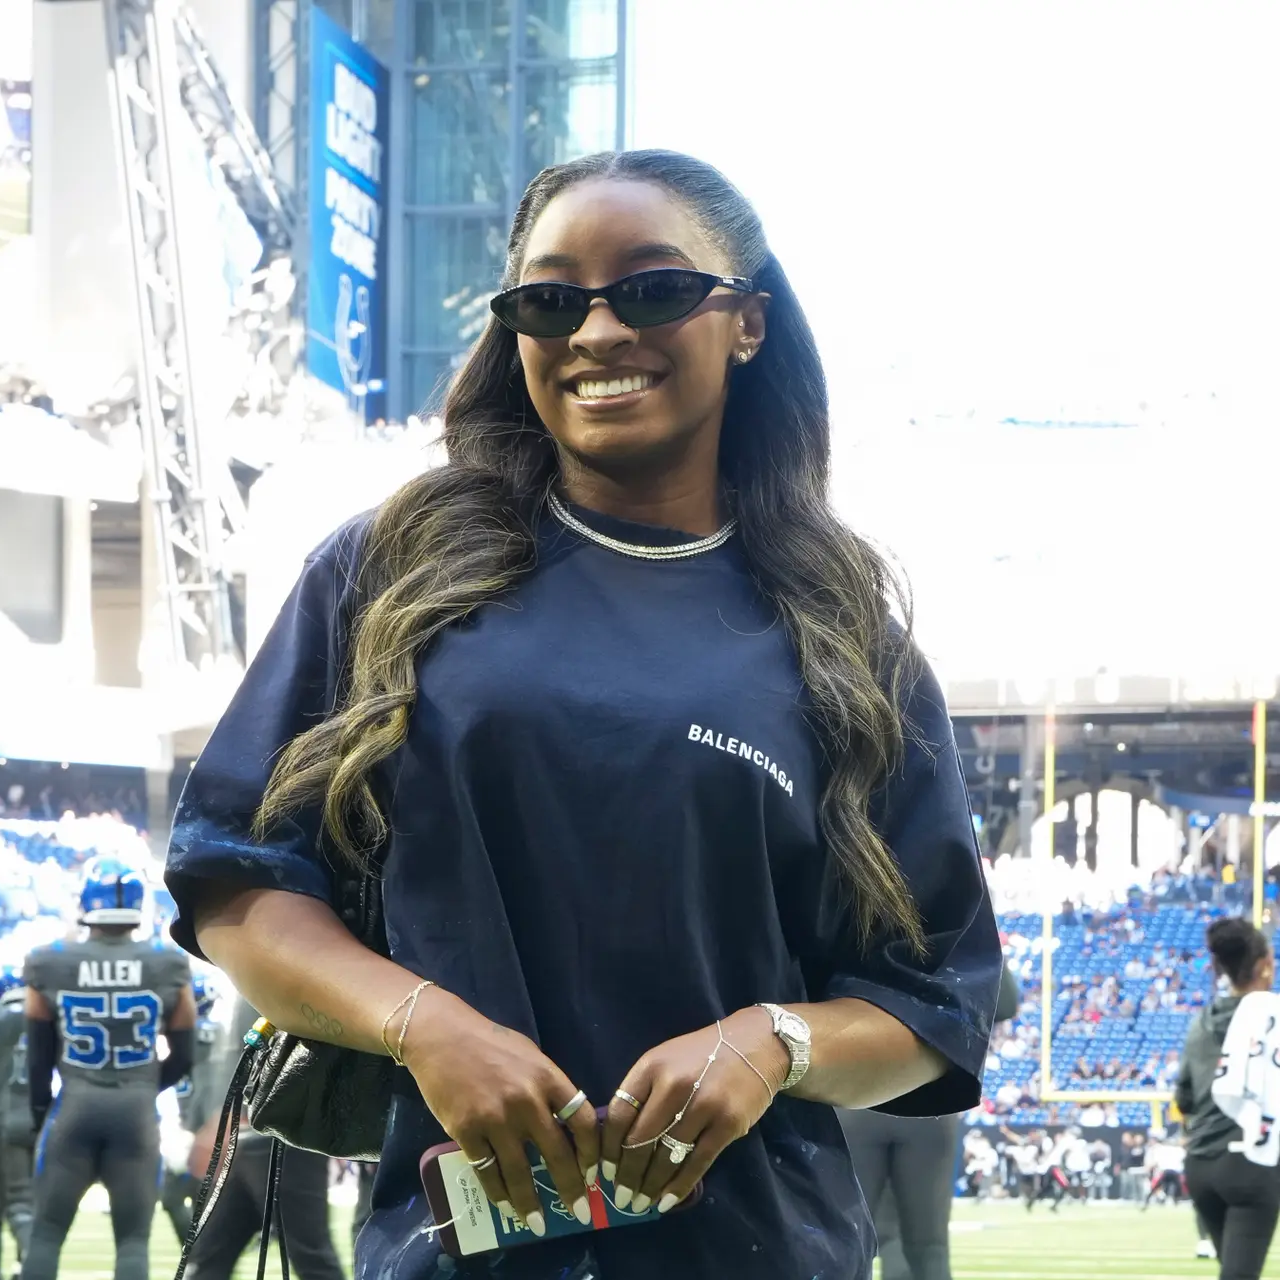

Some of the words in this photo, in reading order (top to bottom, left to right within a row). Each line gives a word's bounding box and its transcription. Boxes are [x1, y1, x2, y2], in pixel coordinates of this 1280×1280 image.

[687, 723, 794, 798] BALENCIAGA
[77, 960, 143, 988] ALLEN
[56, 989, 163, 1070] 53
